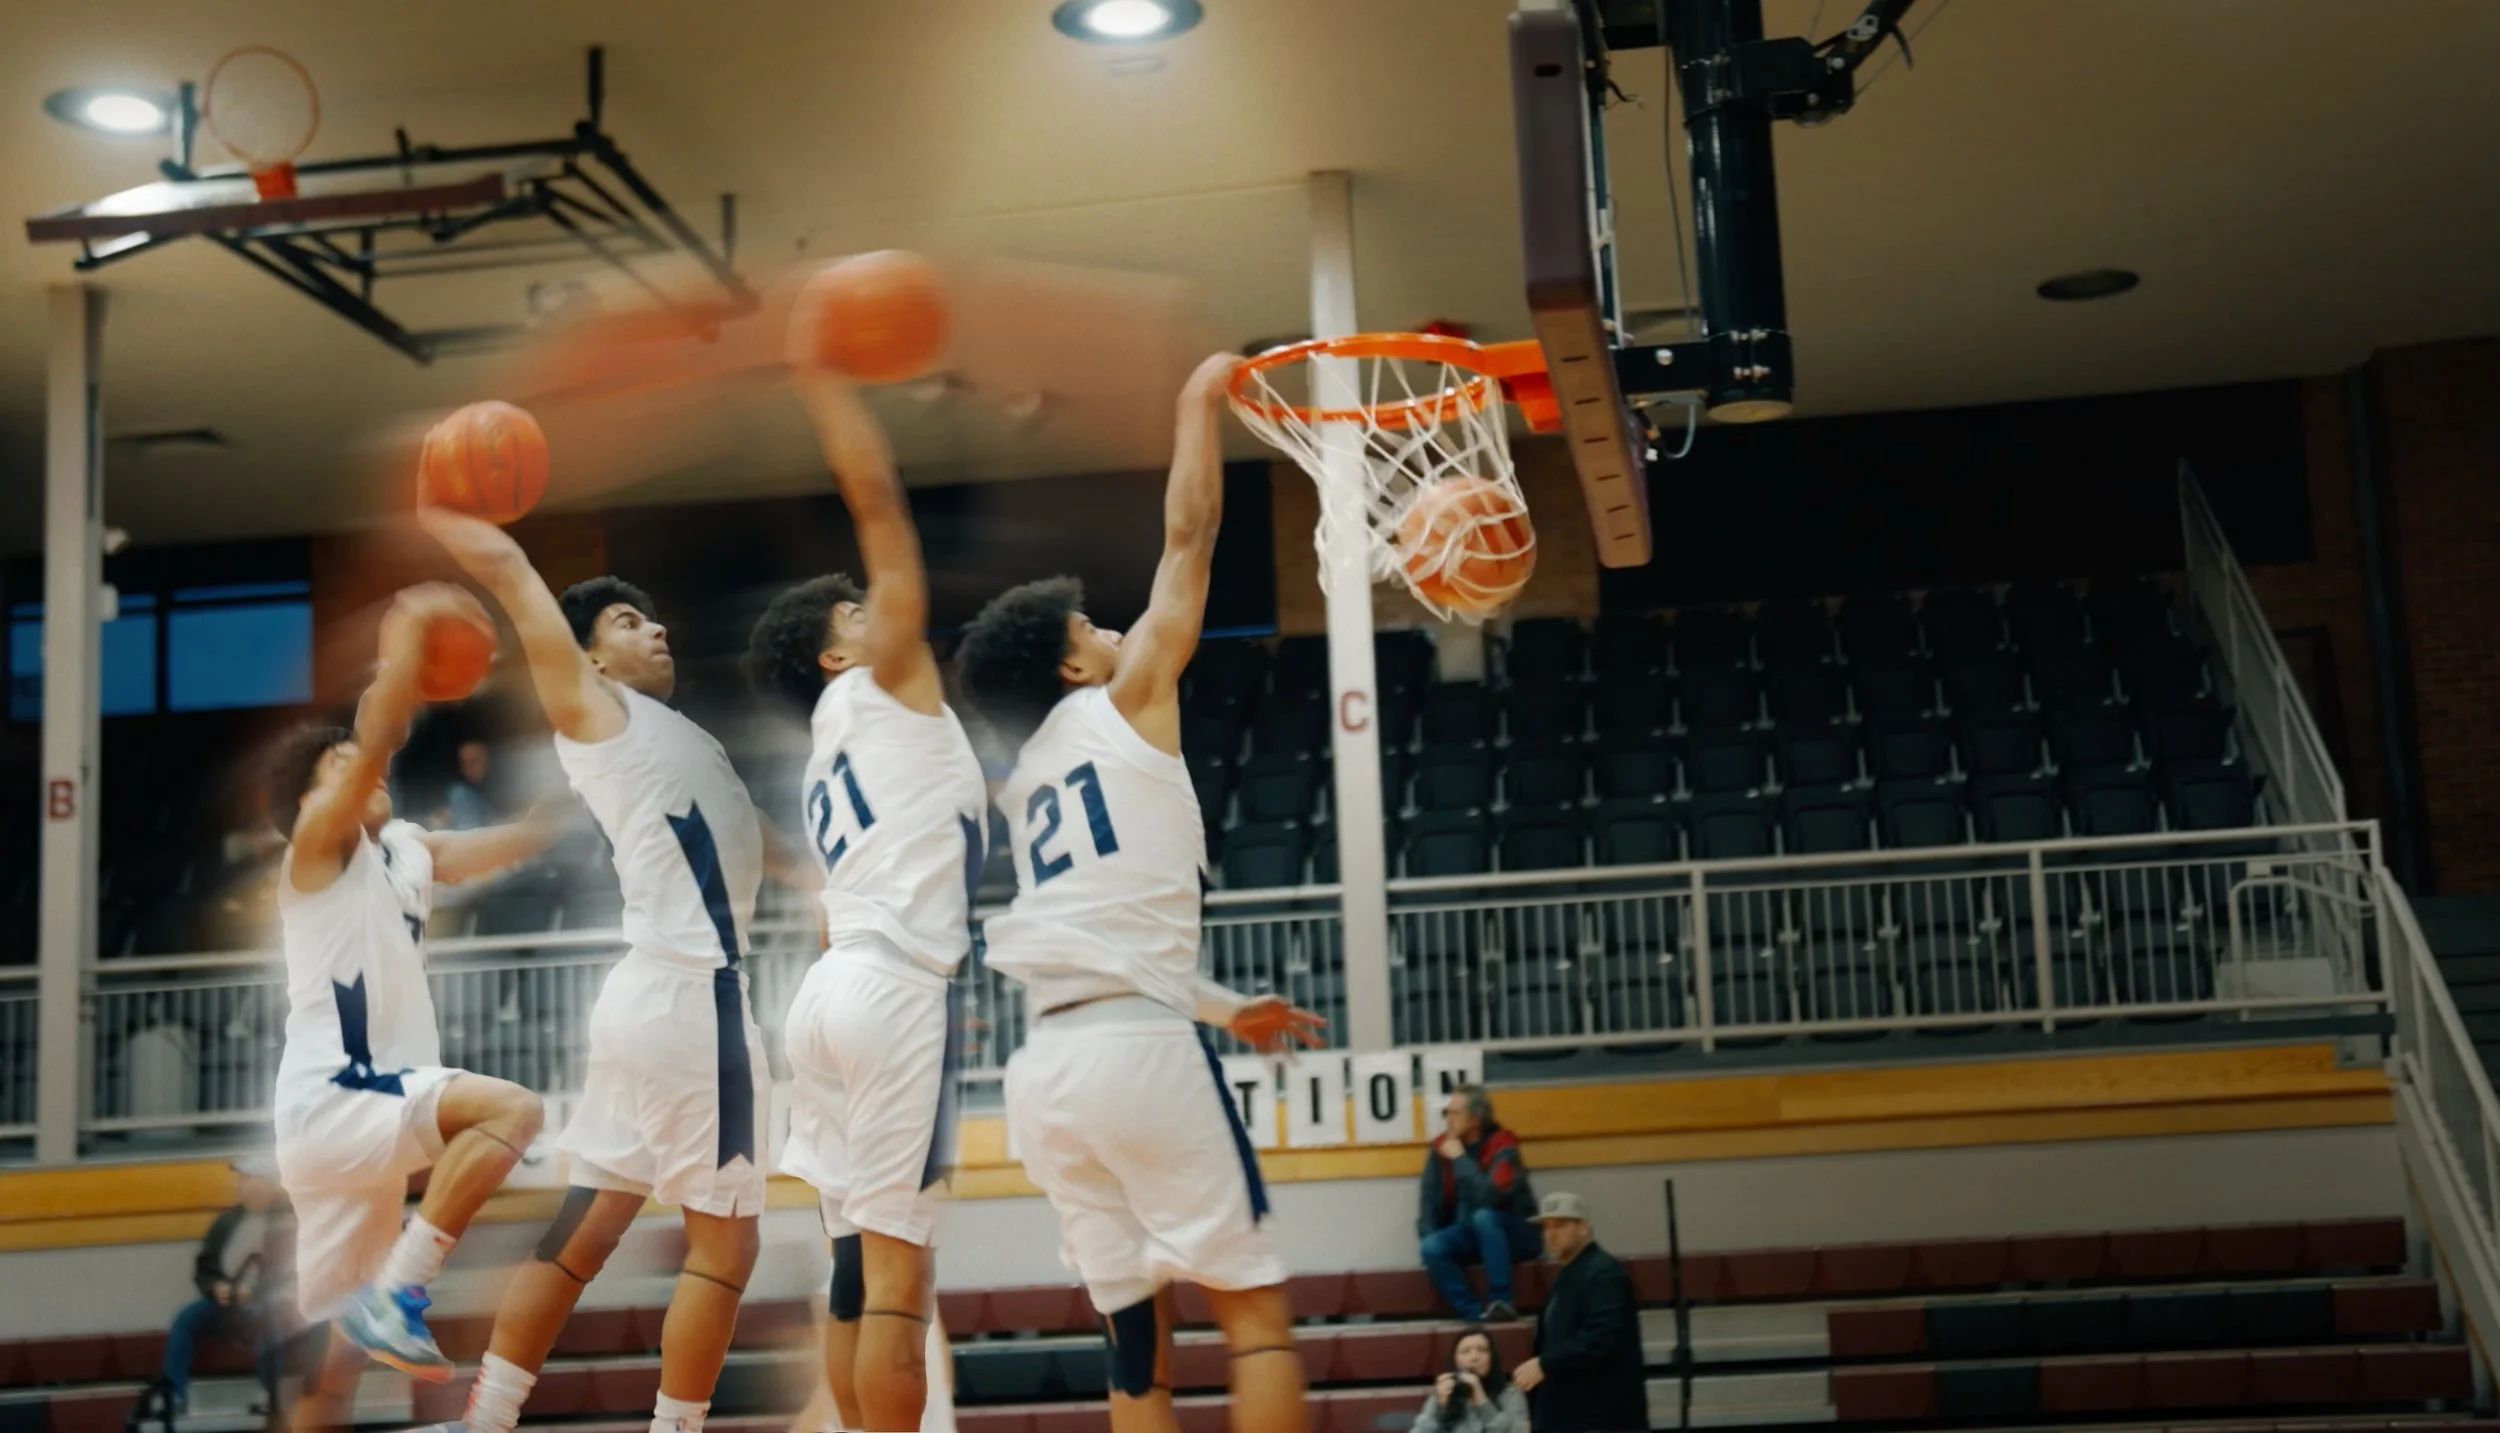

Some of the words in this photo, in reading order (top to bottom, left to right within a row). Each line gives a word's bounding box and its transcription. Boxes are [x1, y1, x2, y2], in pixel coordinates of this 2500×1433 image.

[1340, 691, 1369, 733] C
[48, 779, 75, 820] B
[808, 750, 876, 874] 21
[1027, 760, 1120, 888] 21
